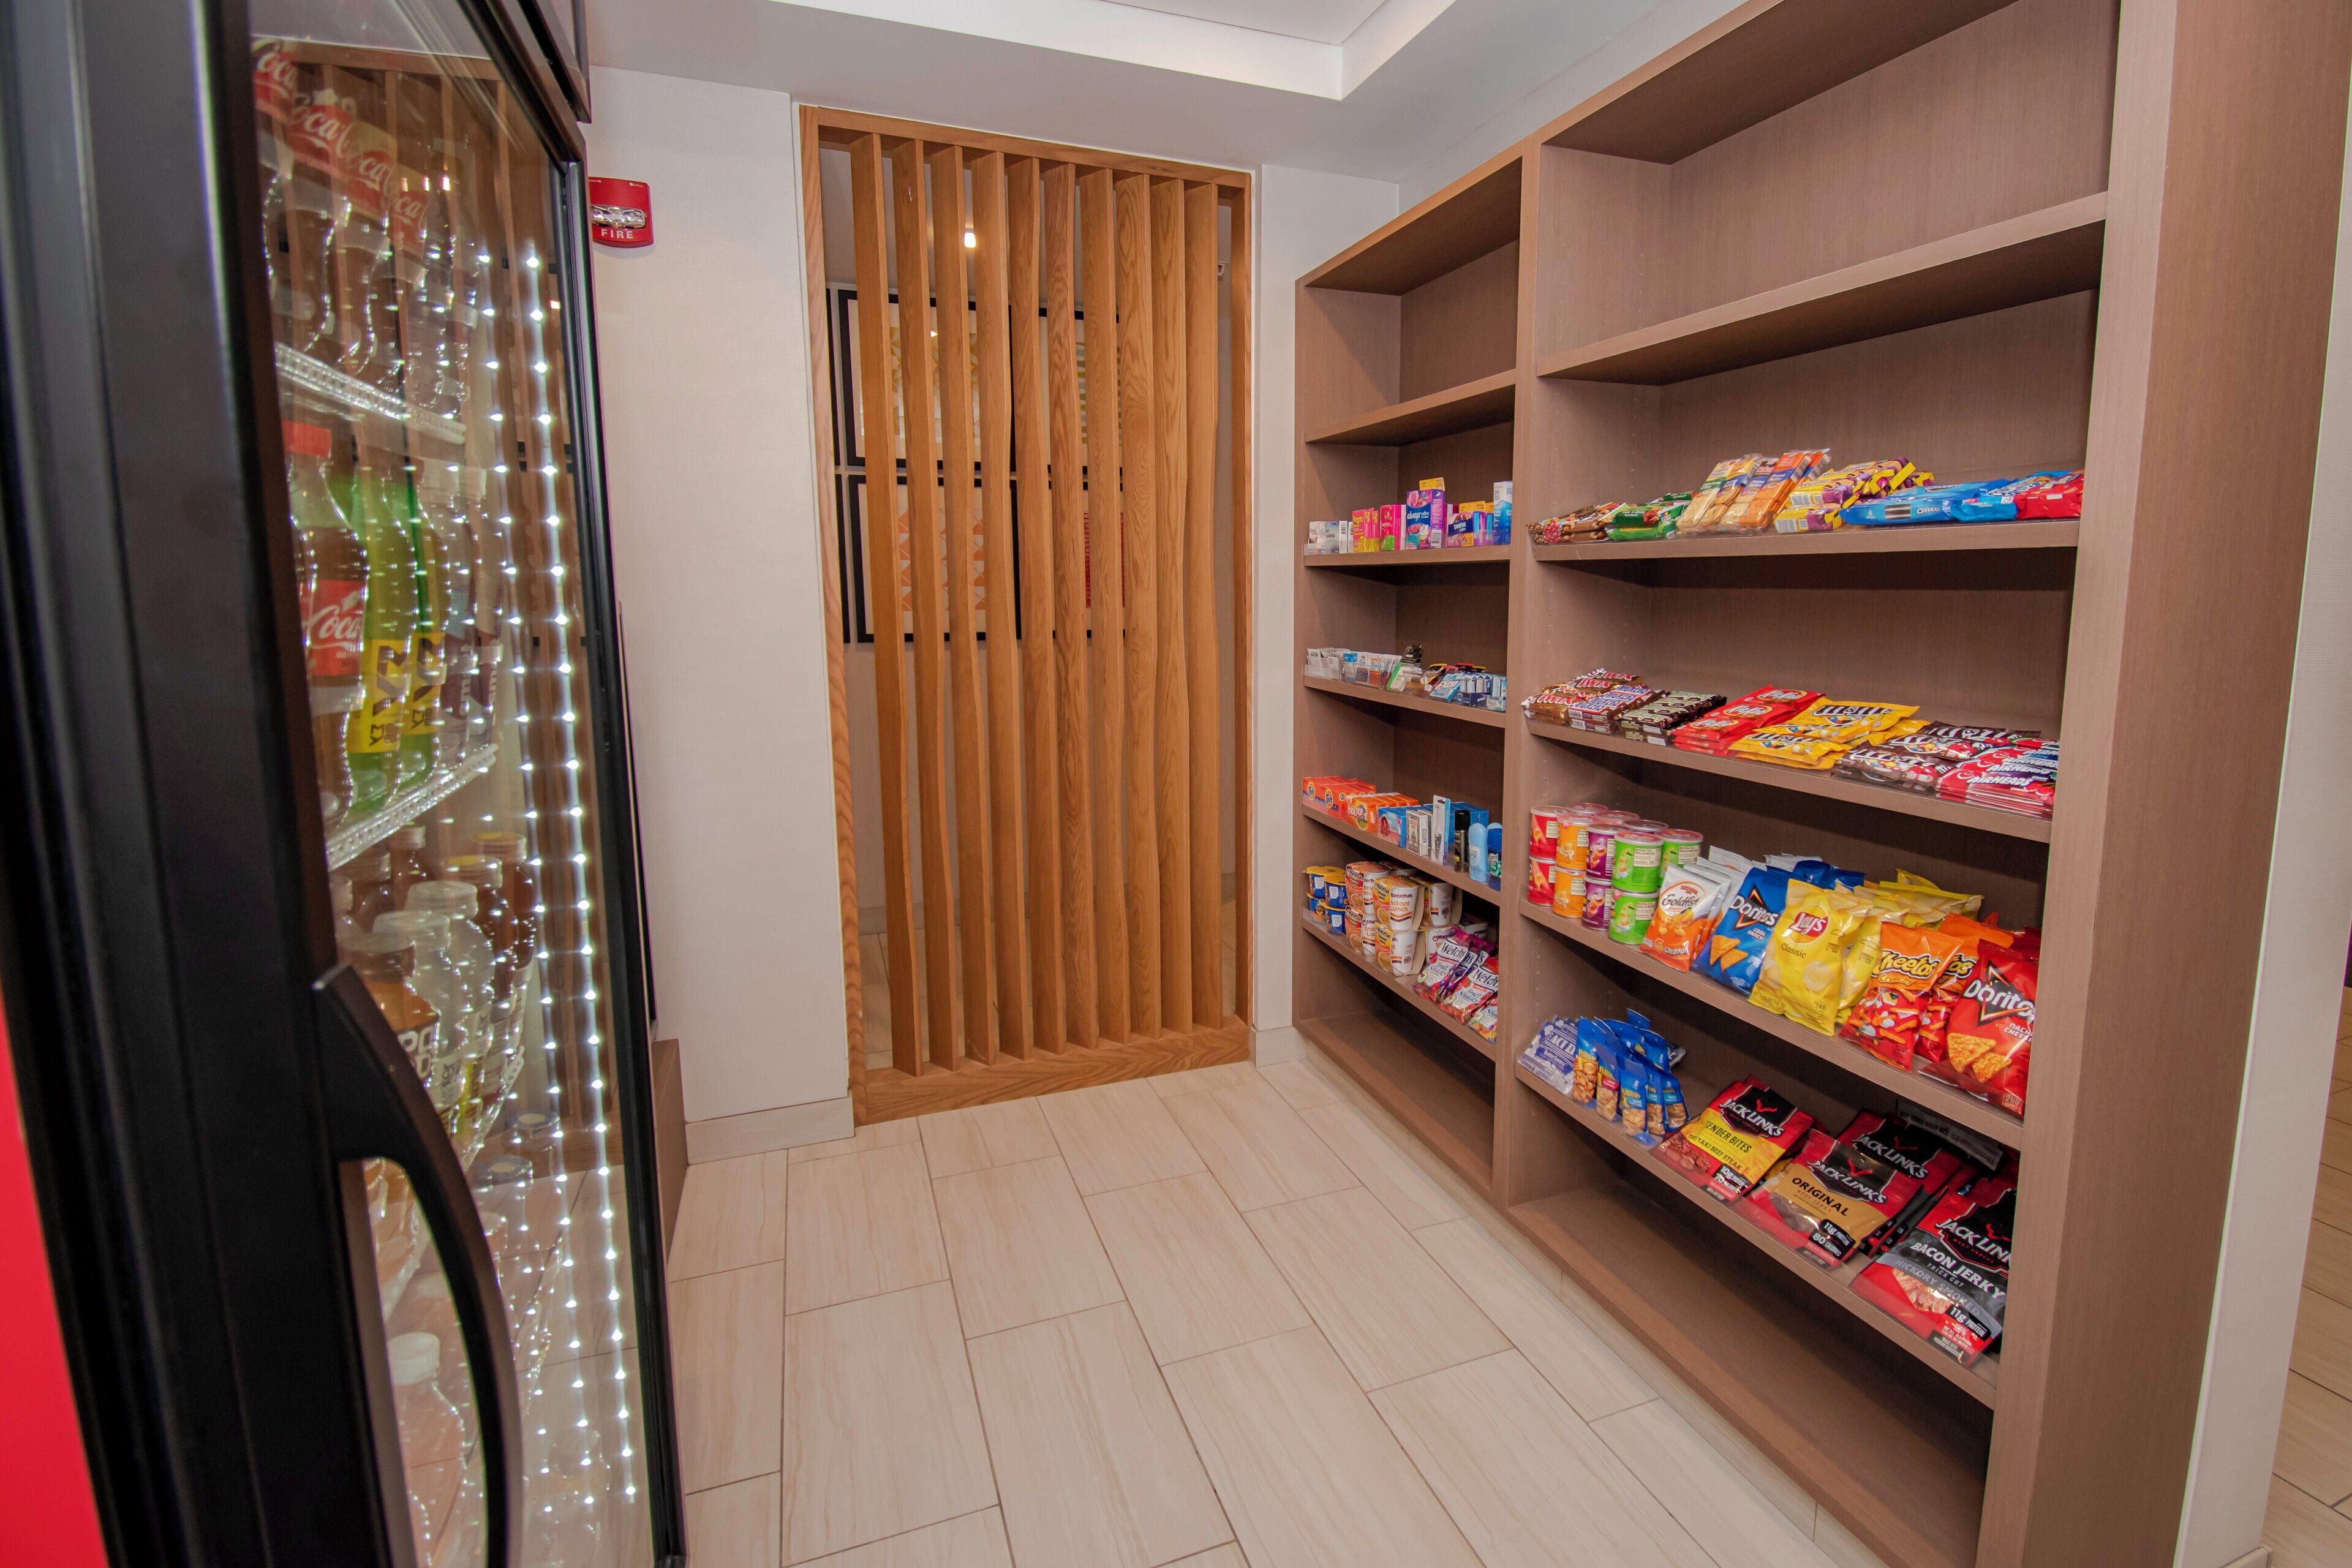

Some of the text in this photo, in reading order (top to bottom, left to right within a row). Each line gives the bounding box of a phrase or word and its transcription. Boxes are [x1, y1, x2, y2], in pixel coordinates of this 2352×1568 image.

[601, 228, 633, 239] FIRE
[1967, 776, 2034, 786] AIRHEADS
[1348, 807, 1364, 817] bounce
[1376, 884, 1390, 894] Maruchan
[1729, 895, 1779, 926] Doritos
[1378, 927, 1391, 938] Maruchan
[1790, 912, 1826, 935] Lay's
[1664, 946, 1689, 956] Cheddar
[1781, 943, 1807, 959] Classic
[1815, 1002, 1826, 1011] 240
[1720, 1098, 1785, 1136] JACK LINK'S
[1706, 1121, 1752, 1153] TENDER BITES
[1709, 1145, 1724, 1157] BEEF
[1722, 1155, 1743, 1172] STEAK
[1851, 1133, 1929, 1178] JACK LINK'S
[1807, 1159, 1888, 1204] JACK LINK'S
[1792, 1177, 1850, 1217] ORIGINAL
[1812, 1232, 1826, 1245] 80
[1823, 1221, 1837, 1235] 11g
[1936, 1218, 1981, 1246] JACK
[1910, 1242, 2007, 1300] BACON JERKY
[1926, 1262, 1965, 1287] THICK CUT
[1894, 1259, 1981, 1316] HICKORY SMOKED
[1950, 1306, 1986, 1338] 11g PROTEIN
